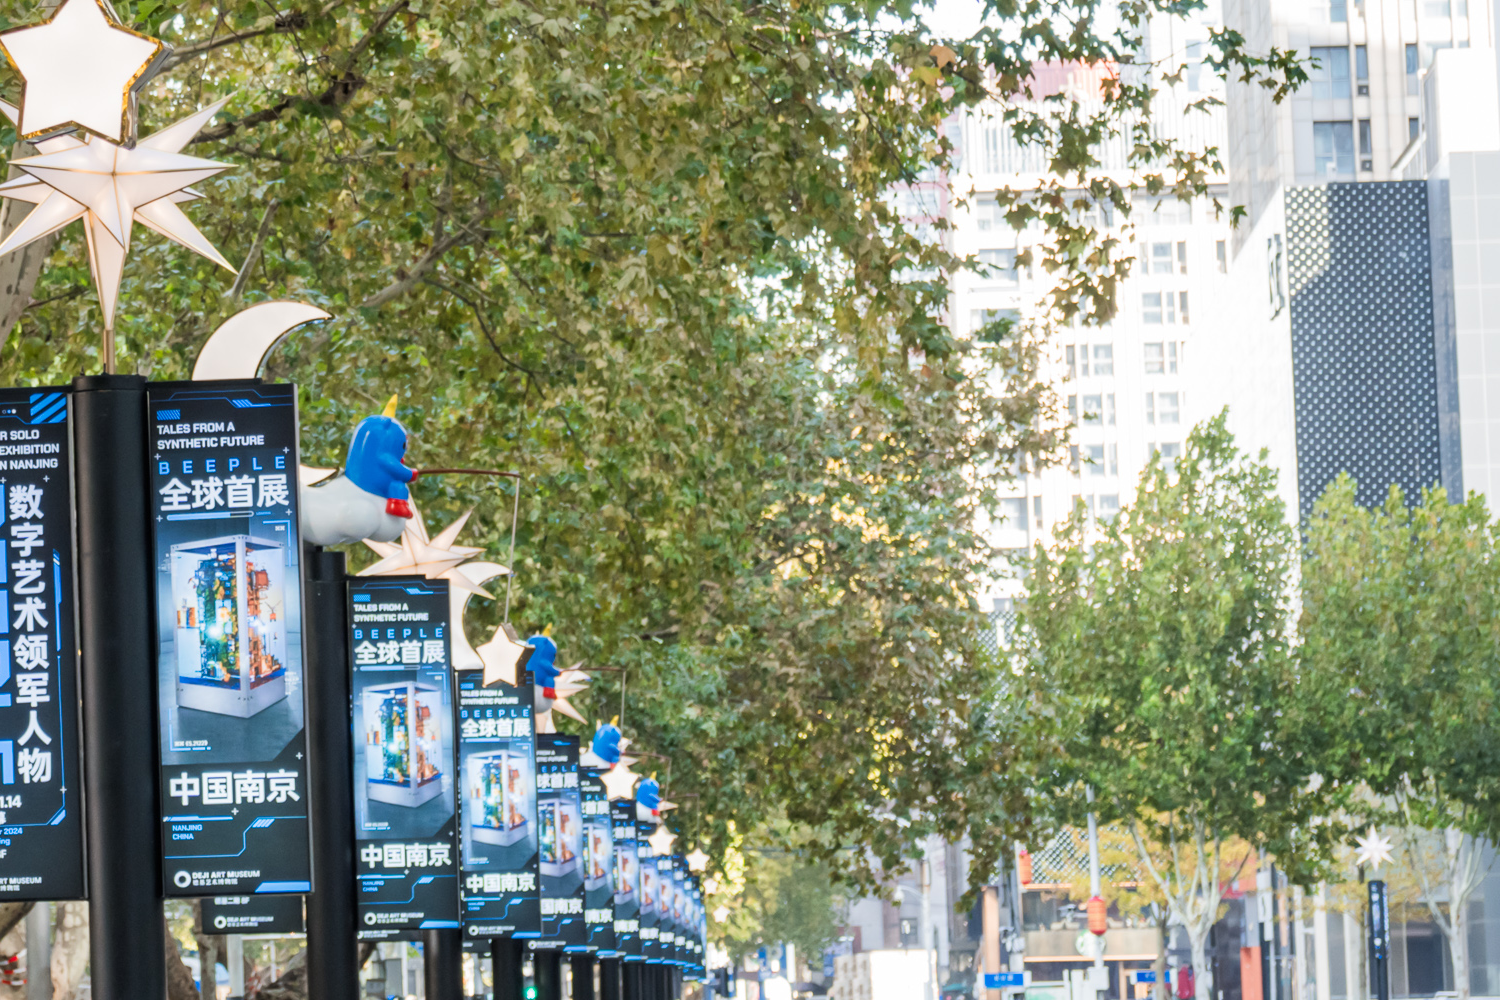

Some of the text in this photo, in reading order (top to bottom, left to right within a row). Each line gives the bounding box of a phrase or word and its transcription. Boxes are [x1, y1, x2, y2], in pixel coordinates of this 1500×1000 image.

[10, 430, 40, 440] SOLO
[157, 422, 235, 434] TALES FROM A
[157, 435, 264, 450] SYNTHETIC FUTURE
[10, 458, 58, 470] NANJING
[158, 456, 285, 475] BEEPLE
[159, 474, 289, 511] 全球首展
[354, 603, 409, 612] TALES FROM A
[354, 613, 429, 622] SYNTHETIC FUTURE
[9, 484, 52, 784] 数字艺术领军人物
[354, 628, 443, 639] BEEPLE
[354, 640, 445, 665] 全球首展
[461, 709, 529, 718] BEEPLE
[461, 718, 531, 737] 全球首展
[541, 765, 577, 773] EPLE
[170, 769, 300, 806] 中国南京
[537, 772, 578, 788] 球首展
[361, 842, 452, 868] 中国南京
[466, 872, 536, 893] 中国南京
[540, 898, 583, 915] 国南京
